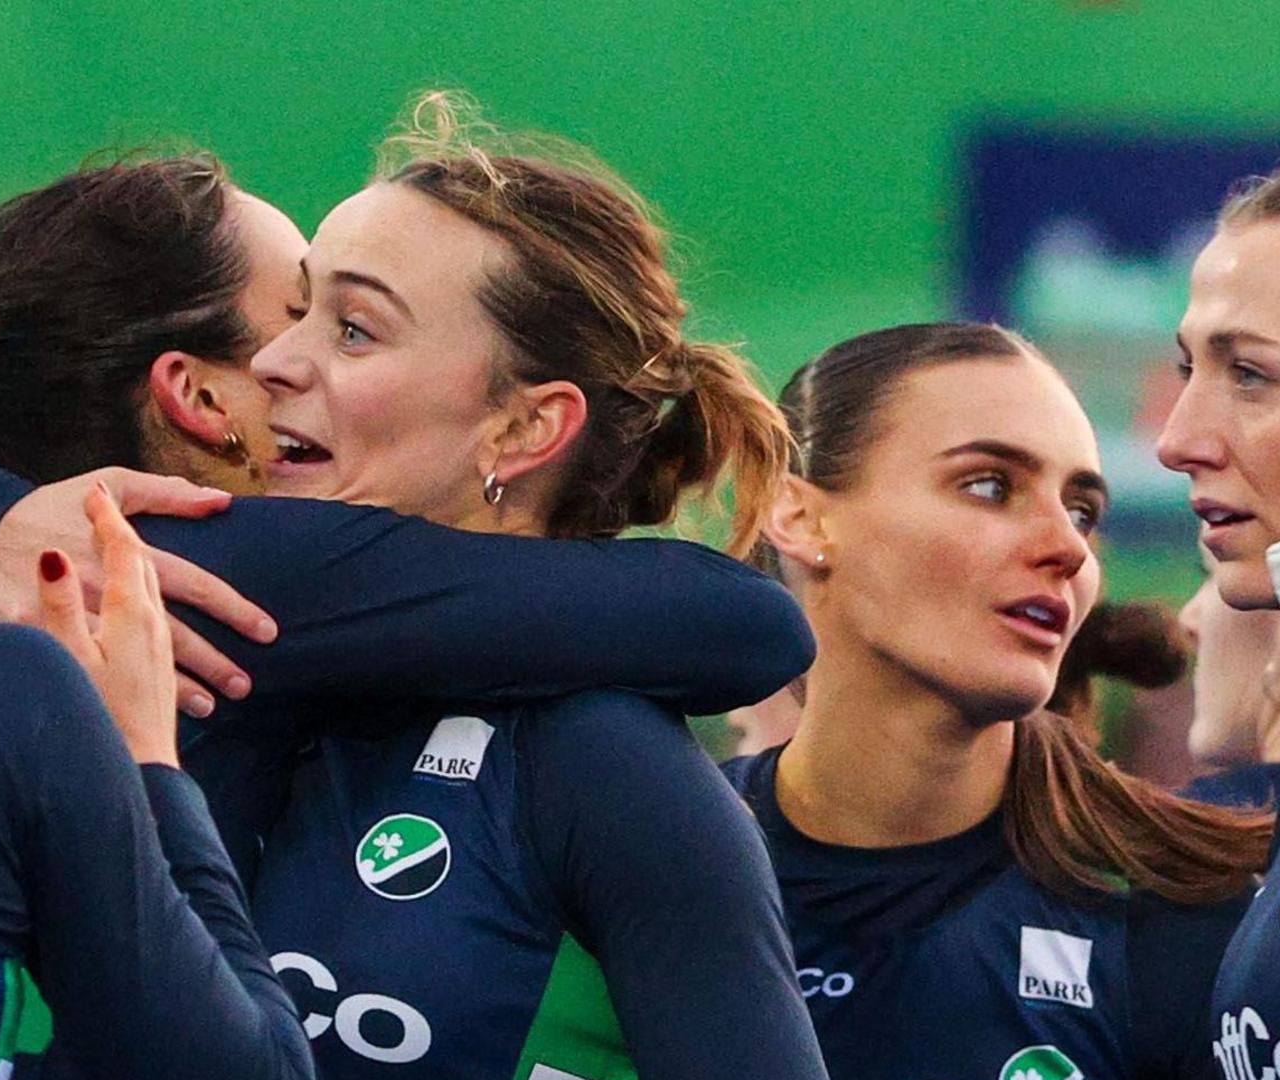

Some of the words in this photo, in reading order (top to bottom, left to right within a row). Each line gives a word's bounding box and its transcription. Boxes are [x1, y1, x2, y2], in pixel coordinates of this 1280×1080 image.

[419, 754, 477, 775] PARK
[796, 967, 855, 997] Co
[1025, 976, 1088, 1003] PARK
[270, 952, 432, 1064] Co
